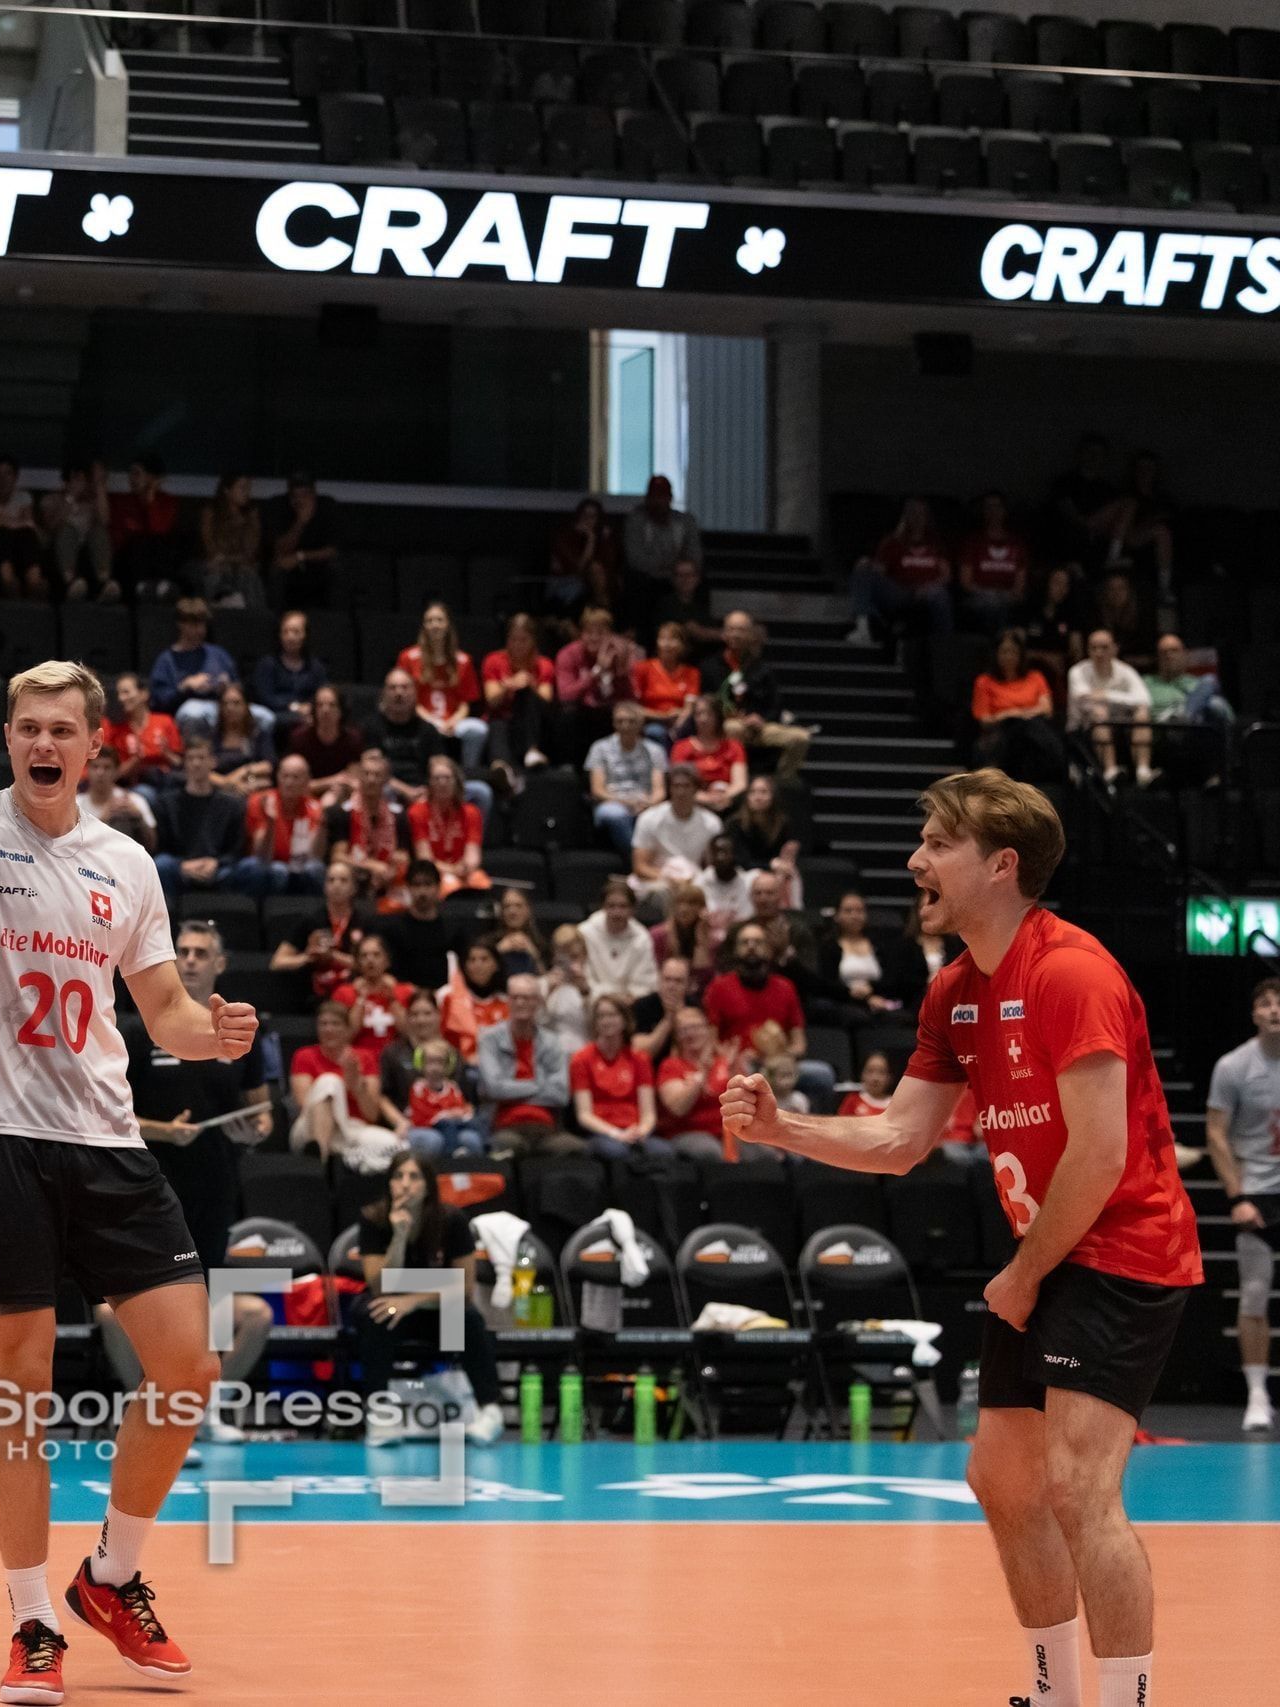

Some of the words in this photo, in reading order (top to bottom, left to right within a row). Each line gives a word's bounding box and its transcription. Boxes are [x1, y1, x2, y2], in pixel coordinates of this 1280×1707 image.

[255, 181, 710, 288] CRAFT
[980, 224, 1280, 315] CRAFTS
[0, 927, 29, 952] die
[31, 930, 110, 968] Mobiliar
[17, 970, 95, 1055] 20
[1035, 1643, 1048, 1680] CRAFT
